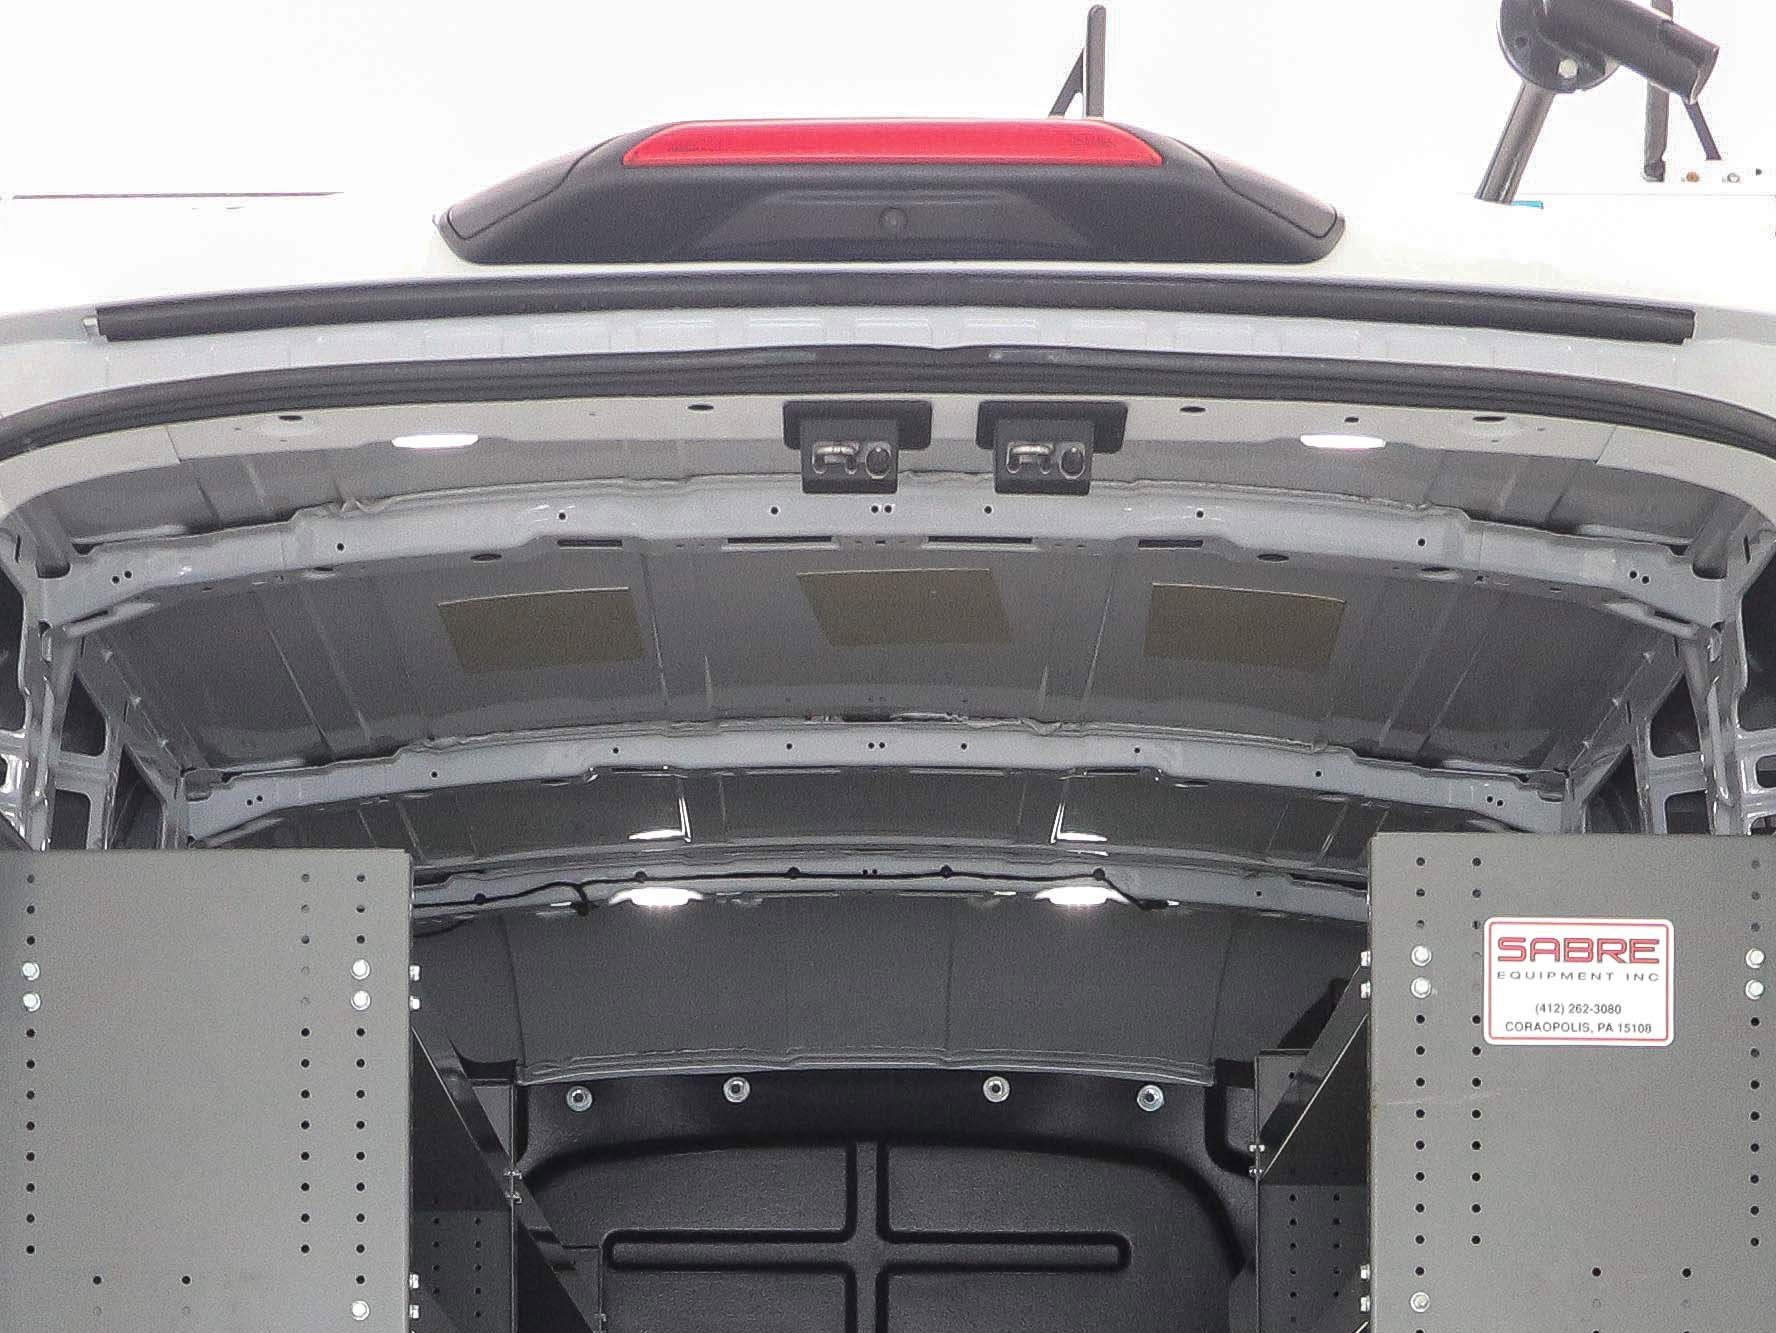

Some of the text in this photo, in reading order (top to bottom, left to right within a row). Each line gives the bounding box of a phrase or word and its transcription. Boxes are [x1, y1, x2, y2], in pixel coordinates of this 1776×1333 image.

[1497, 936, 1661, 964] SABRE
[1496, 971, 1660, 982] EQUIPMENT INC
[1535, 1002, 1565, 1016] (412)
[1505, 1021, 1594, 1034] CORAOPOLIS,
[1597, 1022, 1614, 1033] PA
